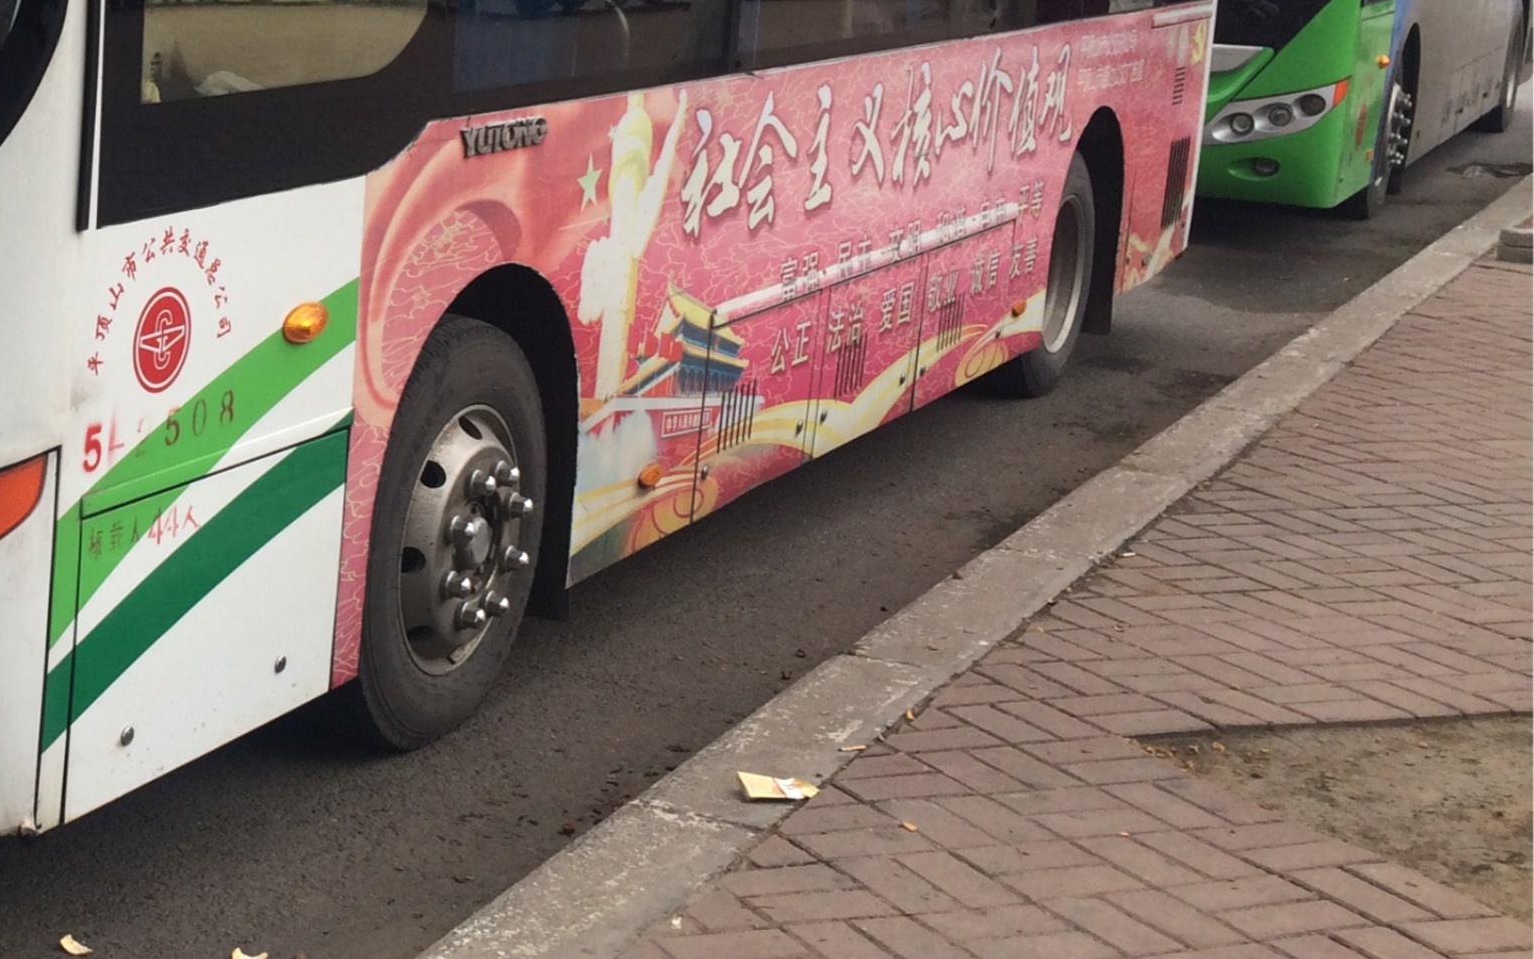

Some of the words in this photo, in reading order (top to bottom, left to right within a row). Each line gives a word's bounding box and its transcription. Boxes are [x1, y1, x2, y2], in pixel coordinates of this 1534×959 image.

[460, 116, 548, 158] YUTONG
[680, 43, 1072, 239] 社会主义核心价值观
[87, 225, 232, 376] 平顶山市公共交通总公司
[770, 320, 812, 375] 公正
[826, 302, 864, 355] 法治
[878, 280, 915, 333] 爱国
[926, 268, 960, 313] 敬业
[970, 250, 1001, 296] 诚信
[1009, 236, 1038, 280] 友善
[780, 252, 819, 302] 富强
[835, 237, 872, 281] 民主
[888, 219, 922, 263] 文明
[1016, 180, 1045, 225] 平等
